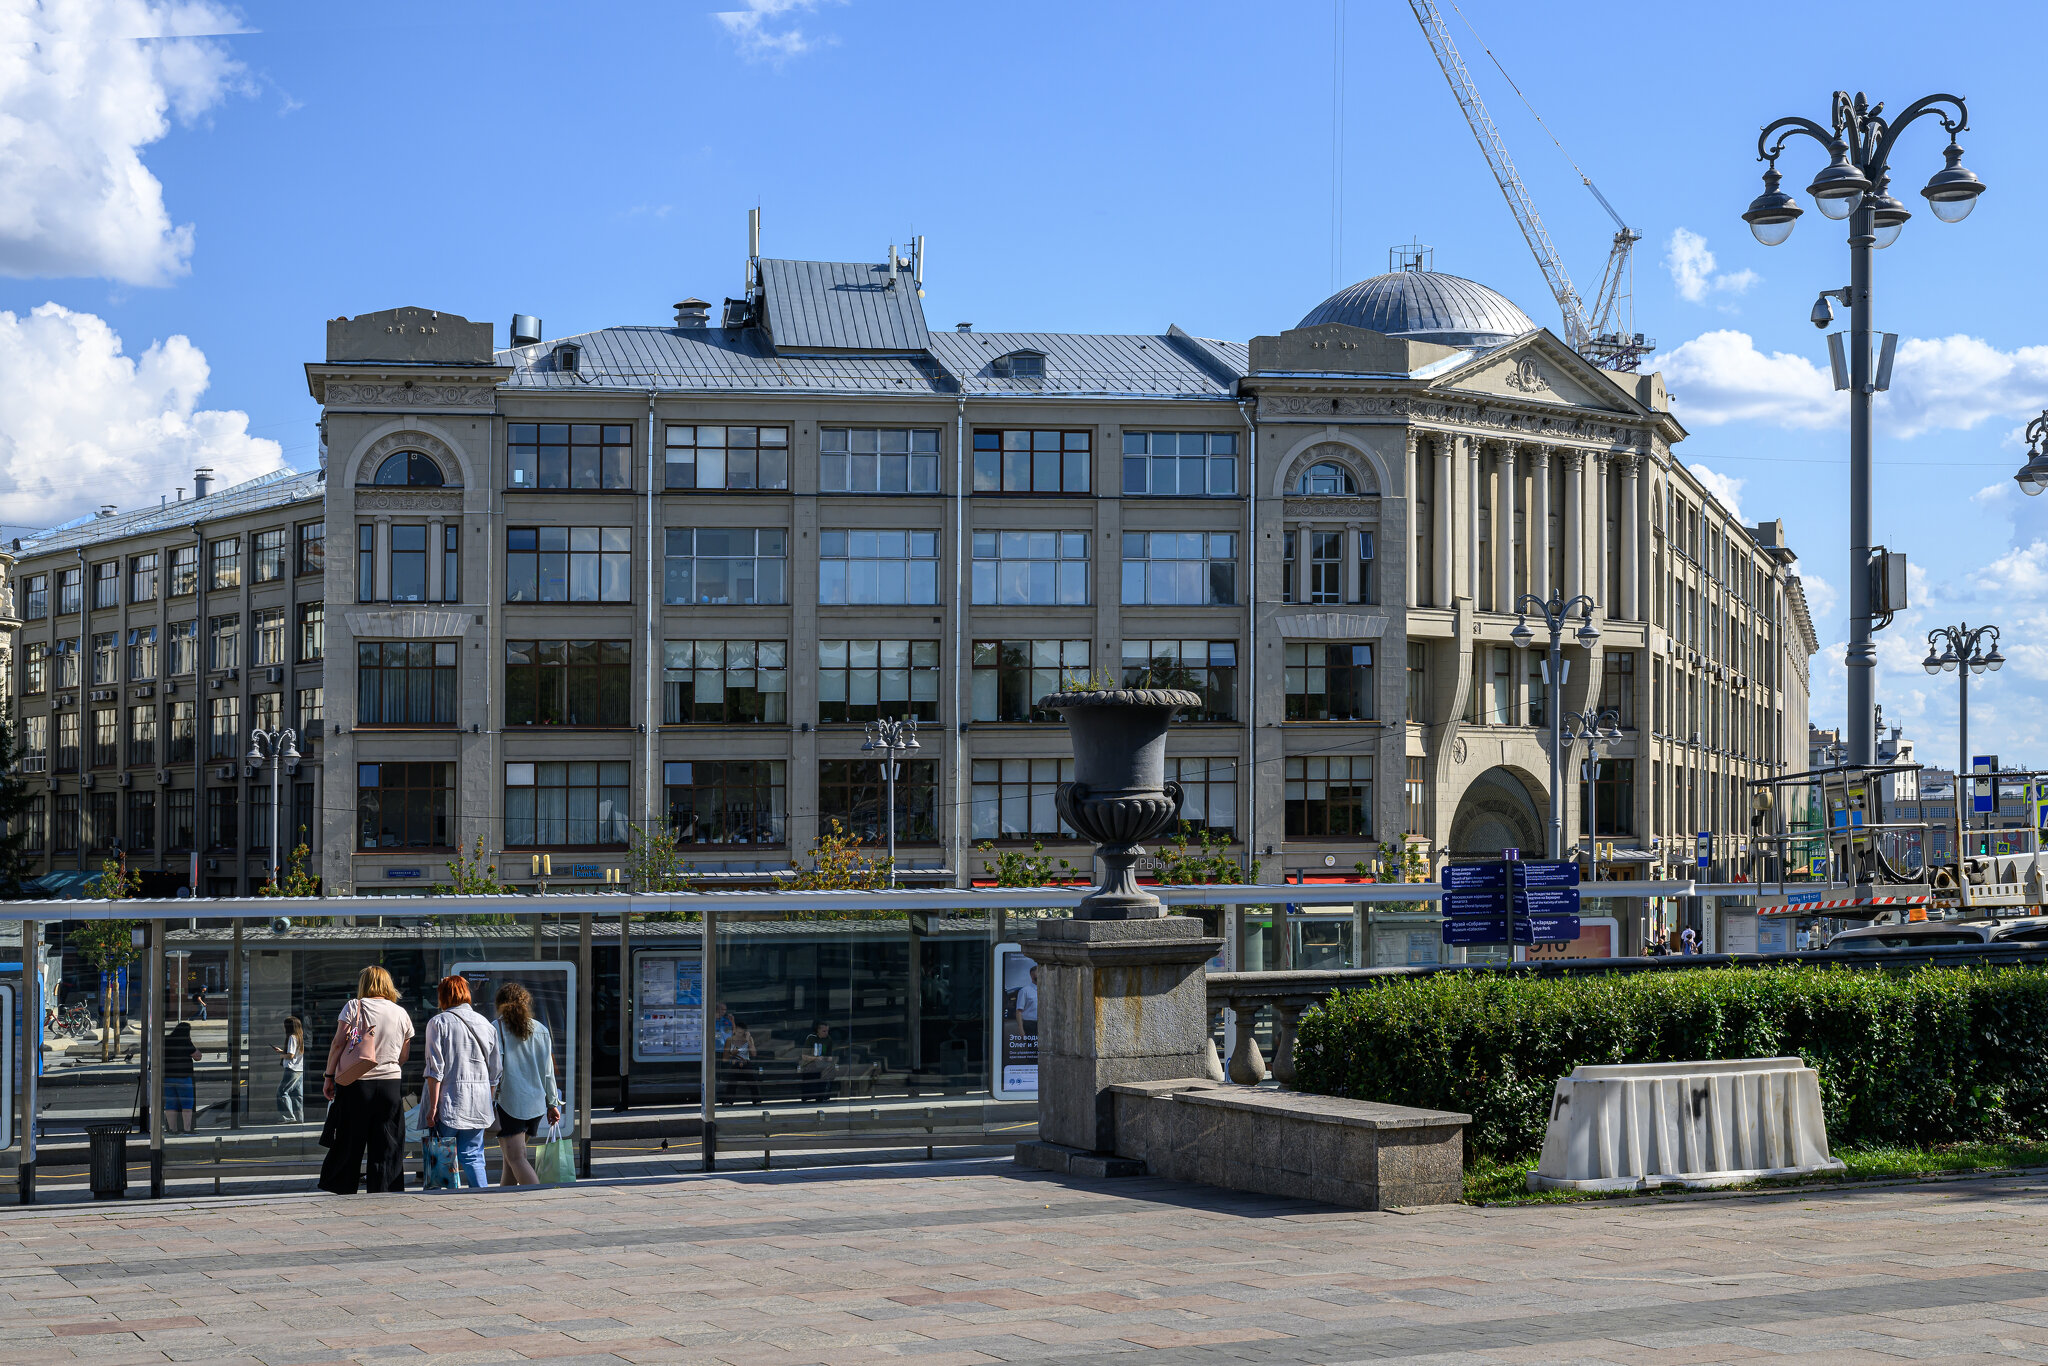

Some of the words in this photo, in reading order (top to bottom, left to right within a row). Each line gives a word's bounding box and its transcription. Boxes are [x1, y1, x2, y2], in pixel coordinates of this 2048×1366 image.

[576, 863, 600, 871] Private
[576, 870, 603, 879] Banking
[1009, 1033, 1022, 1041] Это
